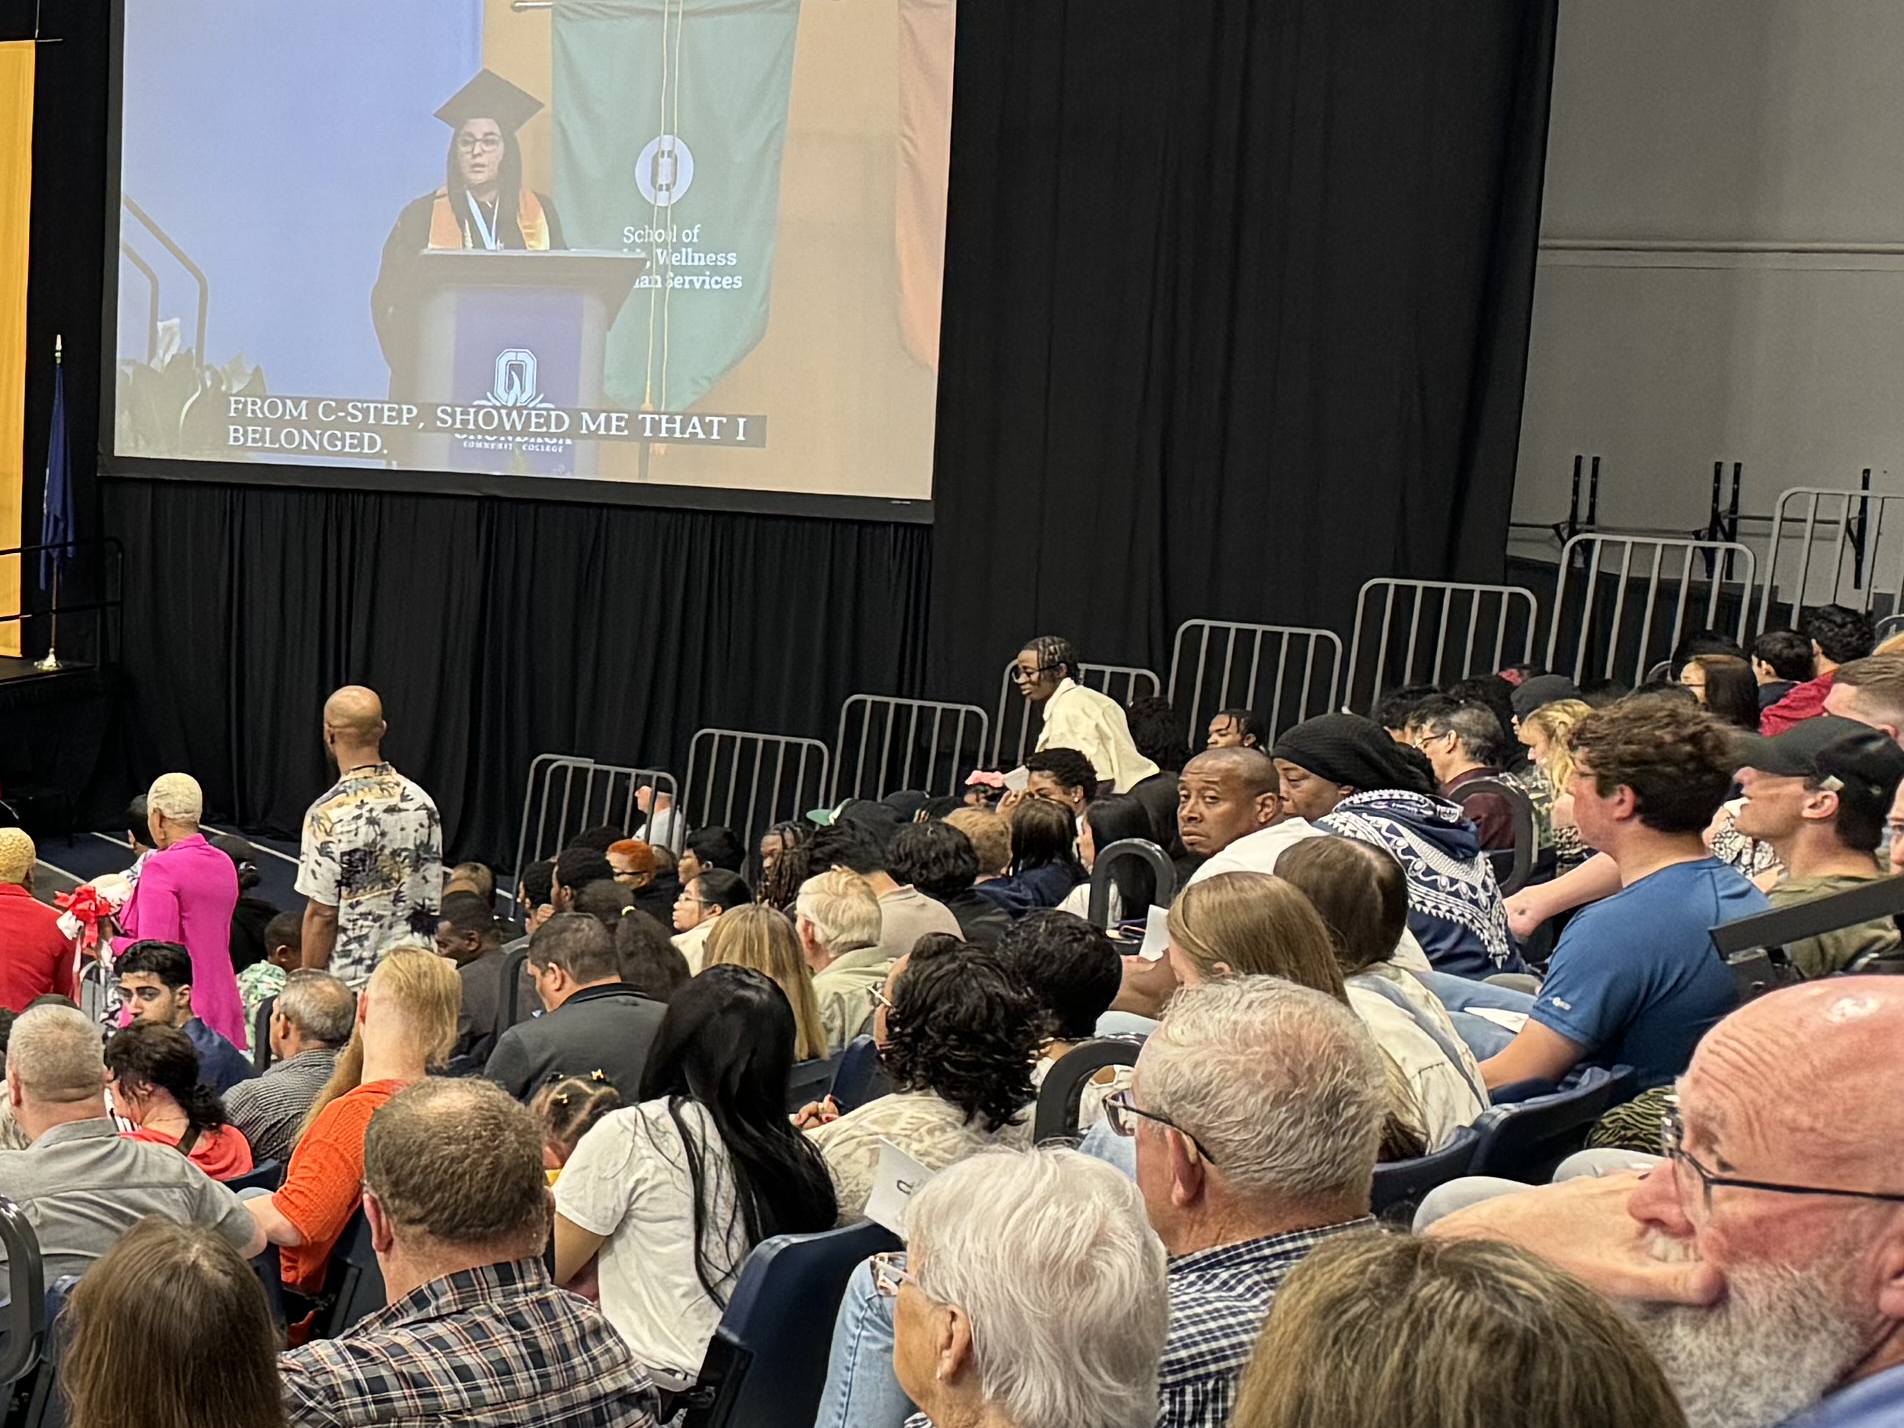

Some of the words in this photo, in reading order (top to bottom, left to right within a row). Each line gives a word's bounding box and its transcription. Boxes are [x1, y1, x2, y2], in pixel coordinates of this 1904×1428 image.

[623, 224, 677, 244] School
[682, 224, 701, 243] of
[228, 396, 309, 421] FROM
[318, 401, 425, 430] C-STEP,
[436, 406, 570, 433] SHOWED
[580, 411, 629, 436] ME
[638, 414, 727, 440] THAT
[736, 417, 747, 441] I
[228, 425, 389, 454] BELONGED.
